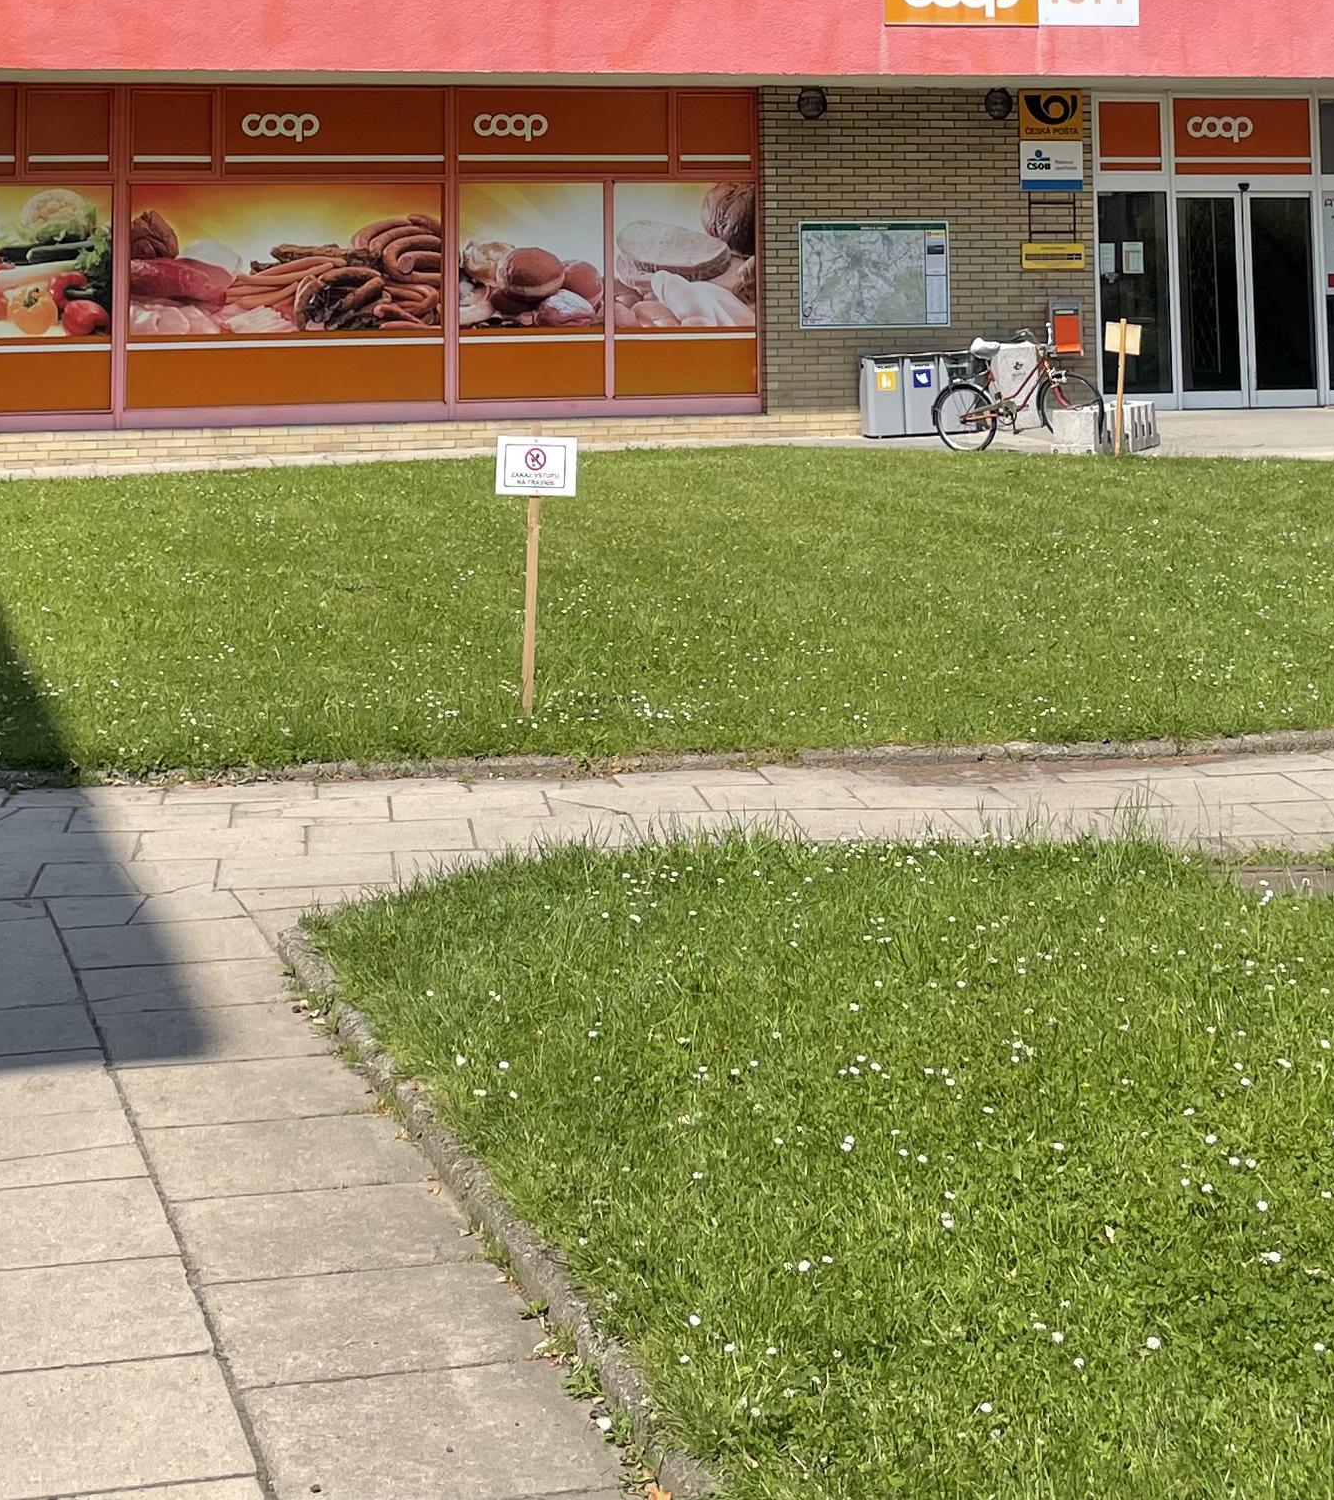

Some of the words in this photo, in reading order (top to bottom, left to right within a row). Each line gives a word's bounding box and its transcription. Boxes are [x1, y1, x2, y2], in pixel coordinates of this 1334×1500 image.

[241, 113, 320, 142] coop
[473, 113, 549, 142] coop
[1186, 116, 1254, 143] coop
